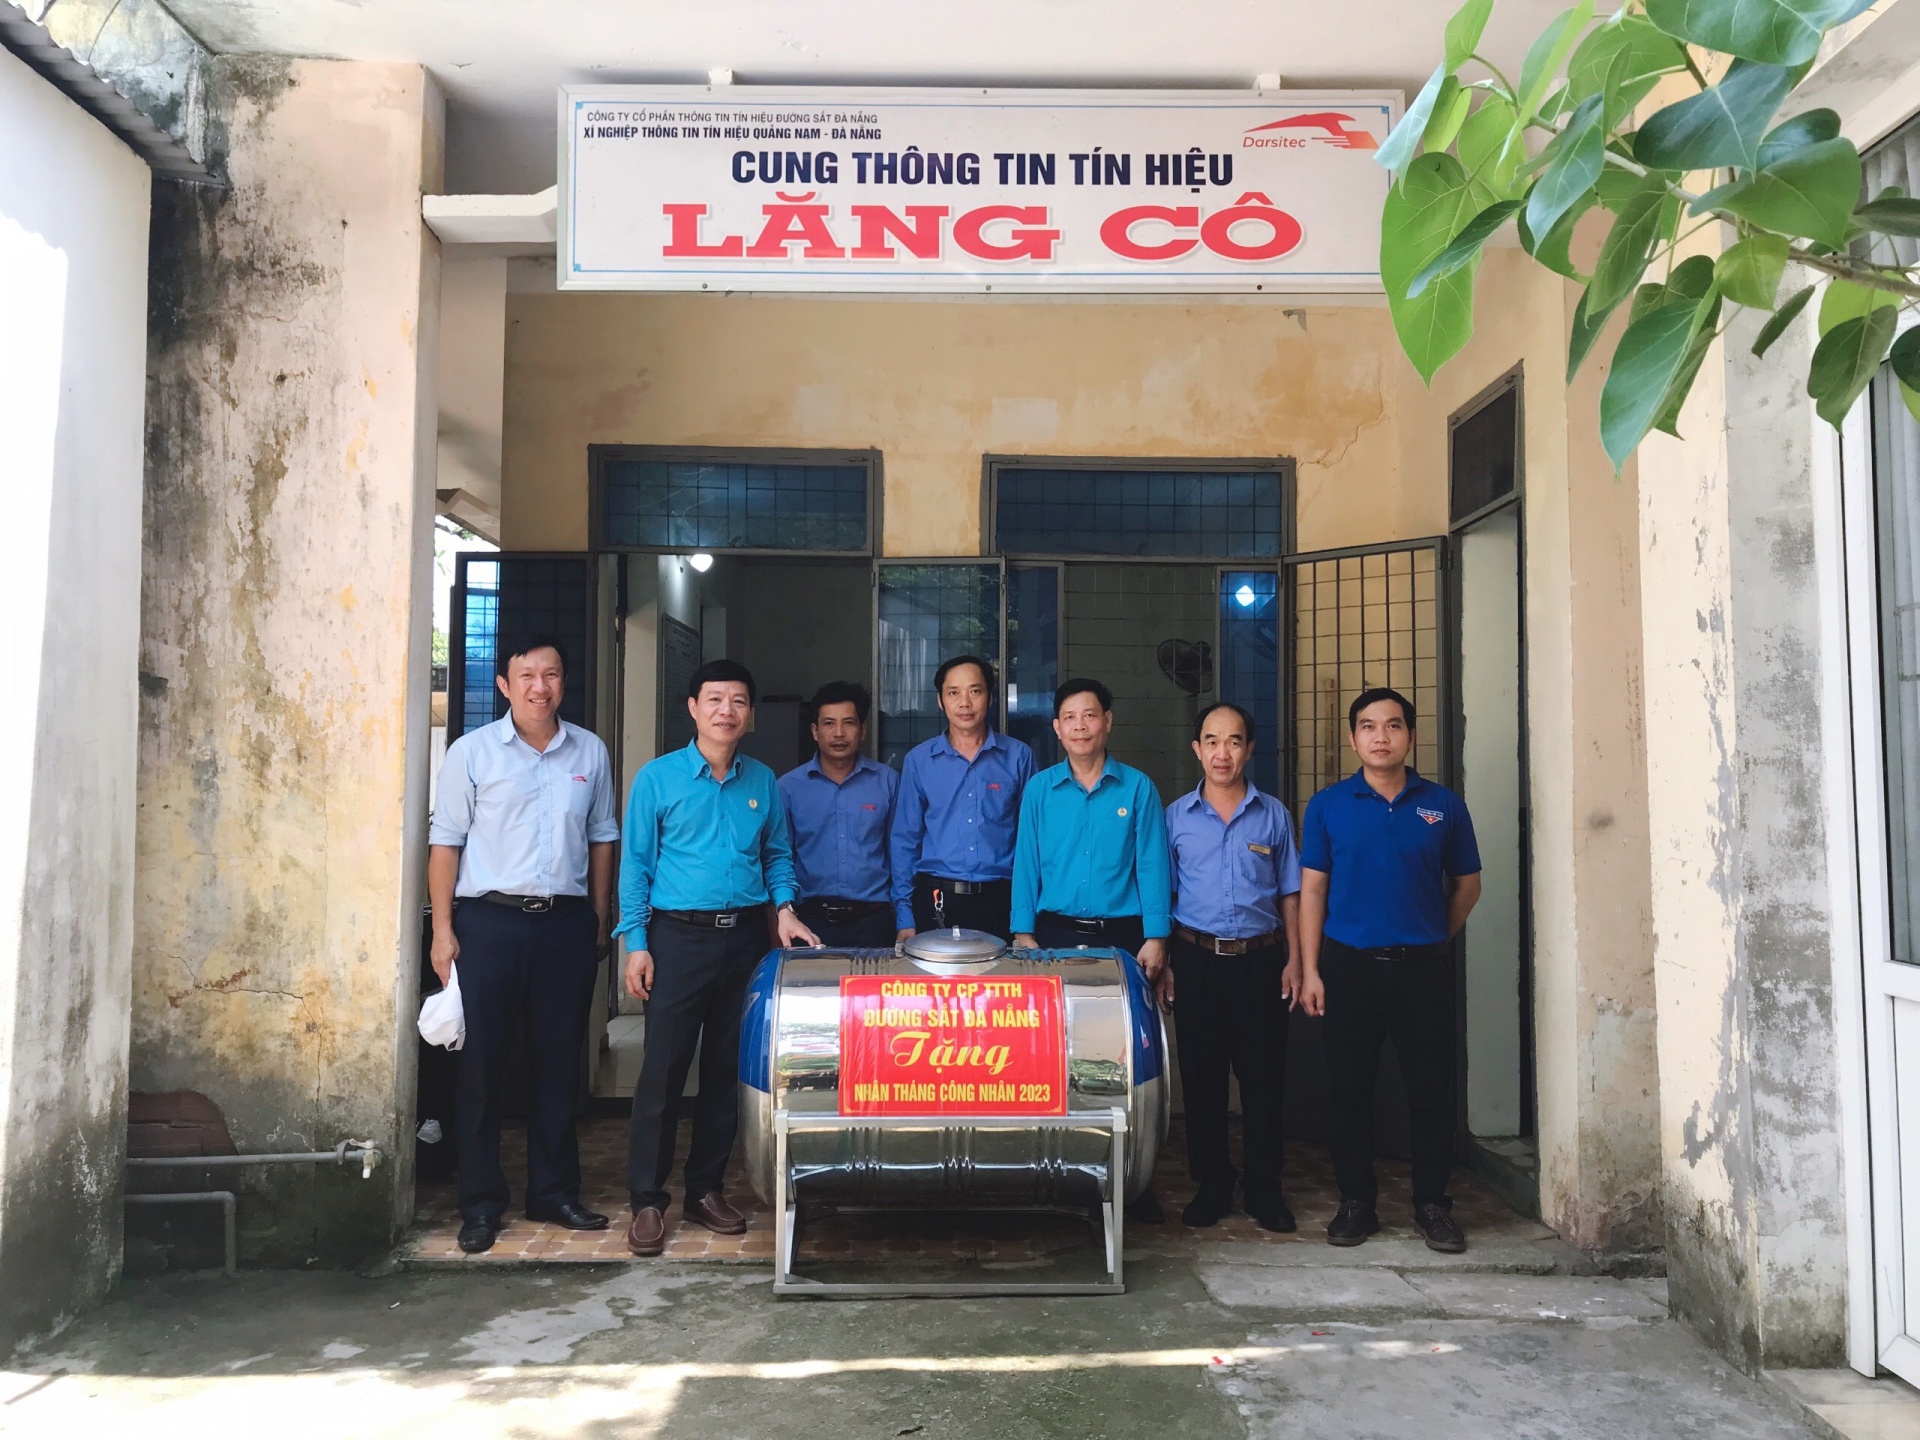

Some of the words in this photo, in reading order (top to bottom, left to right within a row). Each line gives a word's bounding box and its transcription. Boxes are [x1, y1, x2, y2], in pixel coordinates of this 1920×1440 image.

[587, 110, 615, 121] CÔNG
[618, 112, 630, 121] TY
[678, 110, 711, 122] THÔNG
[715, 113, 730, 122] TIN
[733, 110, 748, 122] TÍN
[751, 111, 773, 124] HIỆU
[776, 112, 810, 123] ĐƯỜNG
[813, 110, 831, 123] SẮT
[834, 112, 848, 123] ĐÀ
[583, 125, 594, 138] XÍ
[597, 125, 638, 140] NGHIỆP
[642, 125, 678, 138] THÔNG
[682, 127, 699, 138] TIN
[703, 125, 720, 138] TÍN
[724, 126, 750, 141] HIỆU
[753, 125, 791, 140] QUẢNG
[795, 128, 820, 139] NAM
[831, 126, 847, 140] ĐÀ
[1243, 136, 1306, 148] Darsitec
[732, 150, 838, 184] CUNG
[853, 145, 980, 186] THÔNG
[993, 153, 1056, 186] TIN
[1069, 146, 1131, 186] TÍN
[1145, 147, 1234, 193] HIỆU
[662, 191, 1060, 260] LĂNG
[1099, 191, 1303, 261] CÔ
[881, 980, 927, 998] CÔNG
[932, 983, 950, 997] TY
[956, 982, 978, 997] CP
[984, 983, 1022, 998] TTTH
[864, 1006, 922, 1027] ĐƯỜNG
[927, 1003, 959, 1027] SẮT
[964, 1007, 987, 1027] ĐÀ
[890, 1031, 1013, 1075] Tặng
[854, 1080, 889, 1102] NHÂN
[893, 1080, 936, 1102] THÁNG
[939, 1080, 975, 1102] CÔNG
[979, 1080, 1016, 1102] NHÂN
[1019, 1083, 1051, 1102] 2023
